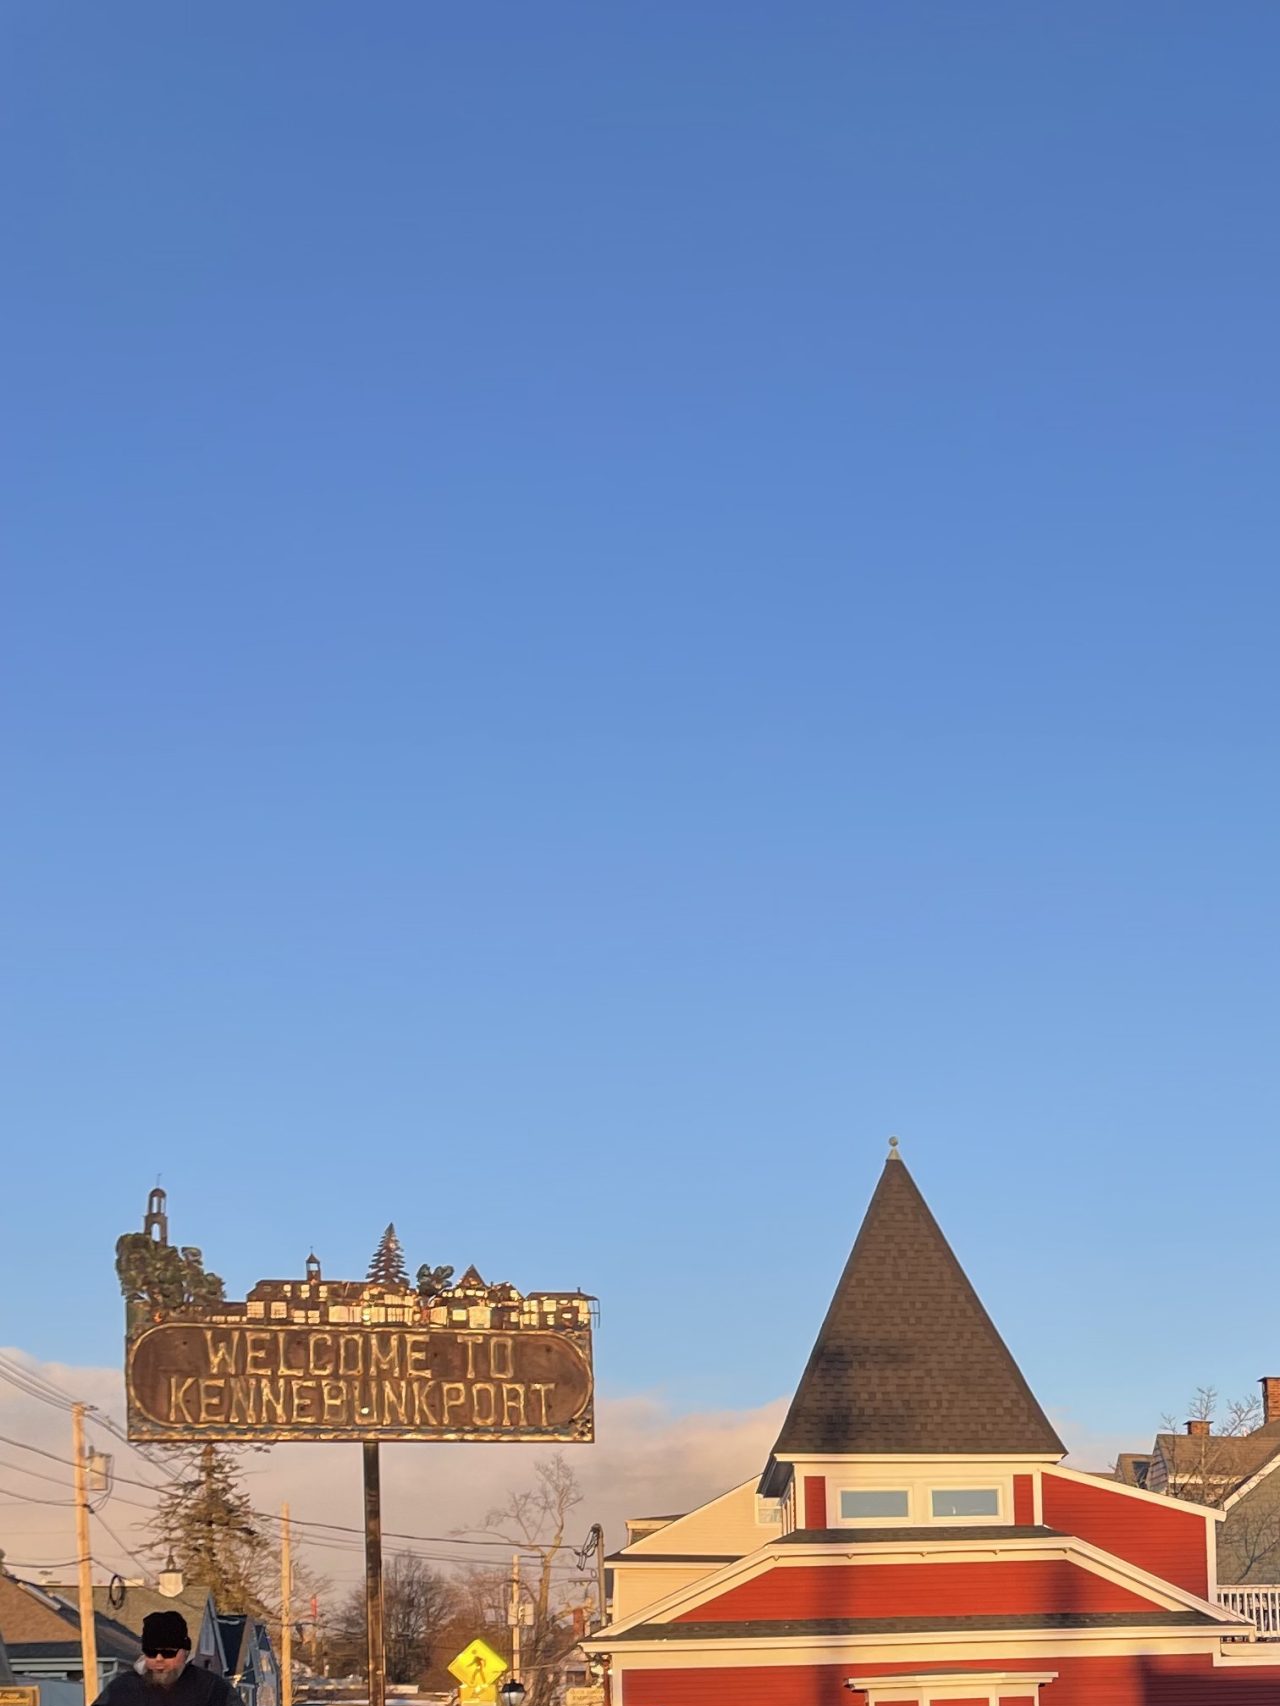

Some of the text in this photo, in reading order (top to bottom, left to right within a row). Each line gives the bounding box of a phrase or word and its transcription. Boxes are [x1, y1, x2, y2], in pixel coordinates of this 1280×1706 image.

[204, 1330, 515, 1379] WELCOME TO
[168, 1376, 556, 1428] KENNEBUNKPORT
